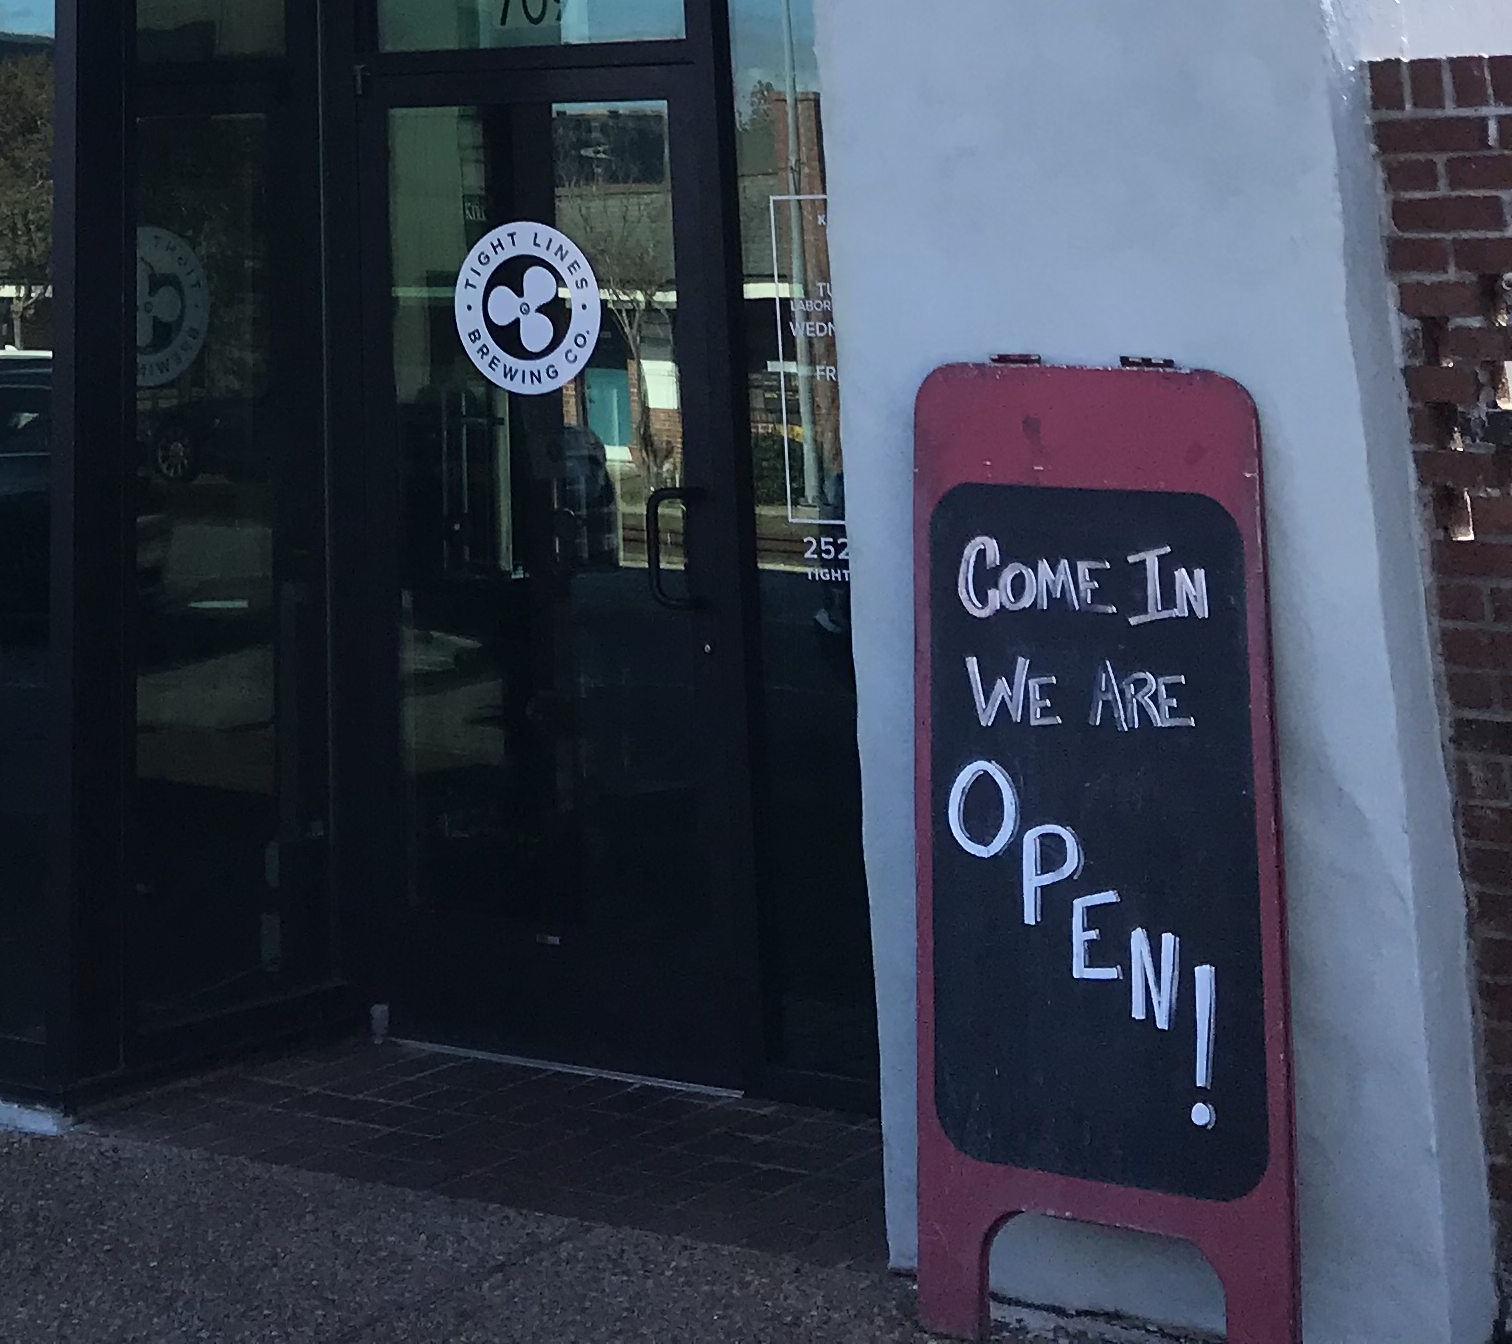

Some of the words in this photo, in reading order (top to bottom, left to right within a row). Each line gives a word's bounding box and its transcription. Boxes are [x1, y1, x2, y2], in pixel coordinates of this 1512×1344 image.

[464, 232, 518, 291] TIGHT
[533, 232, 589, 291] LINES
[790, 300, 832, 312] LABOR
[468, 329, 559, 385] BREWING
[565, 330, 591, 364] CO.
[803, 536, 849, 560] 252
[965, 656, 1062, 727] WE
[1088, 660, 1196, 733] ARE
[948, 760, 1216, 1130] OPEN!
